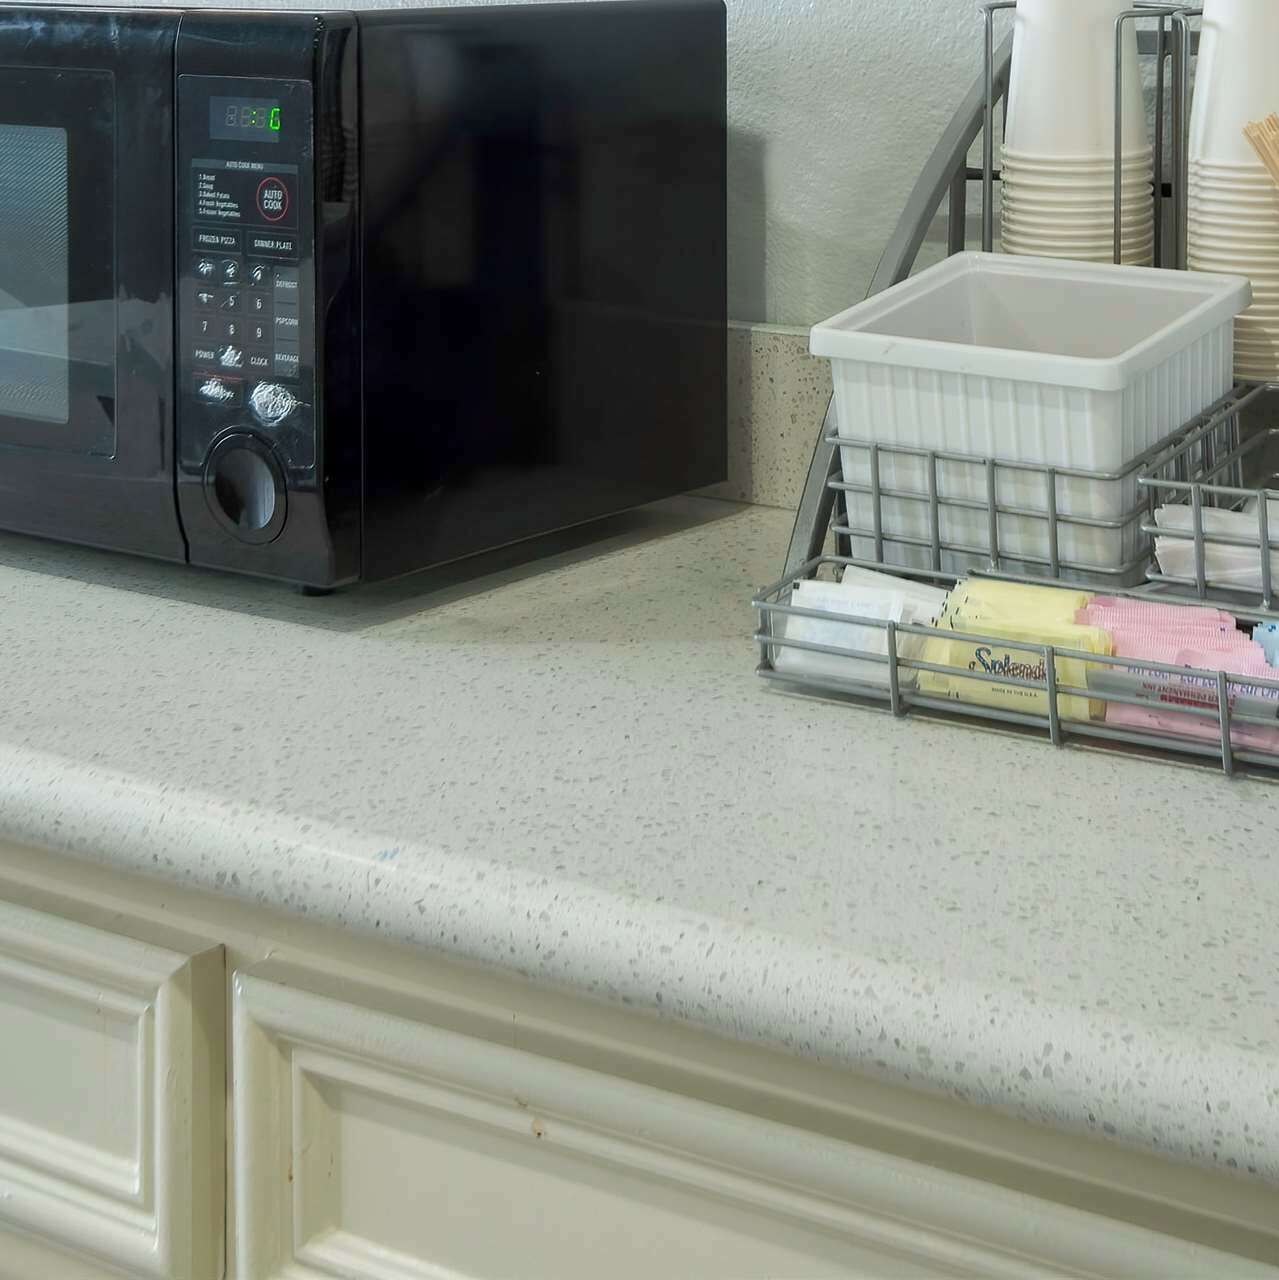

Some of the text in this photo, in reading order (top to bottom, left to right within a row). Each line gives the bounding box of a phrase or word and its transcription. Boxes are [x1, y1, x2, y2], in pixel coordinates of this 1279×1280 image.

[264, 190, 283, 210] AUTO COOK
[275, 317, 298, 325] POPCORN
